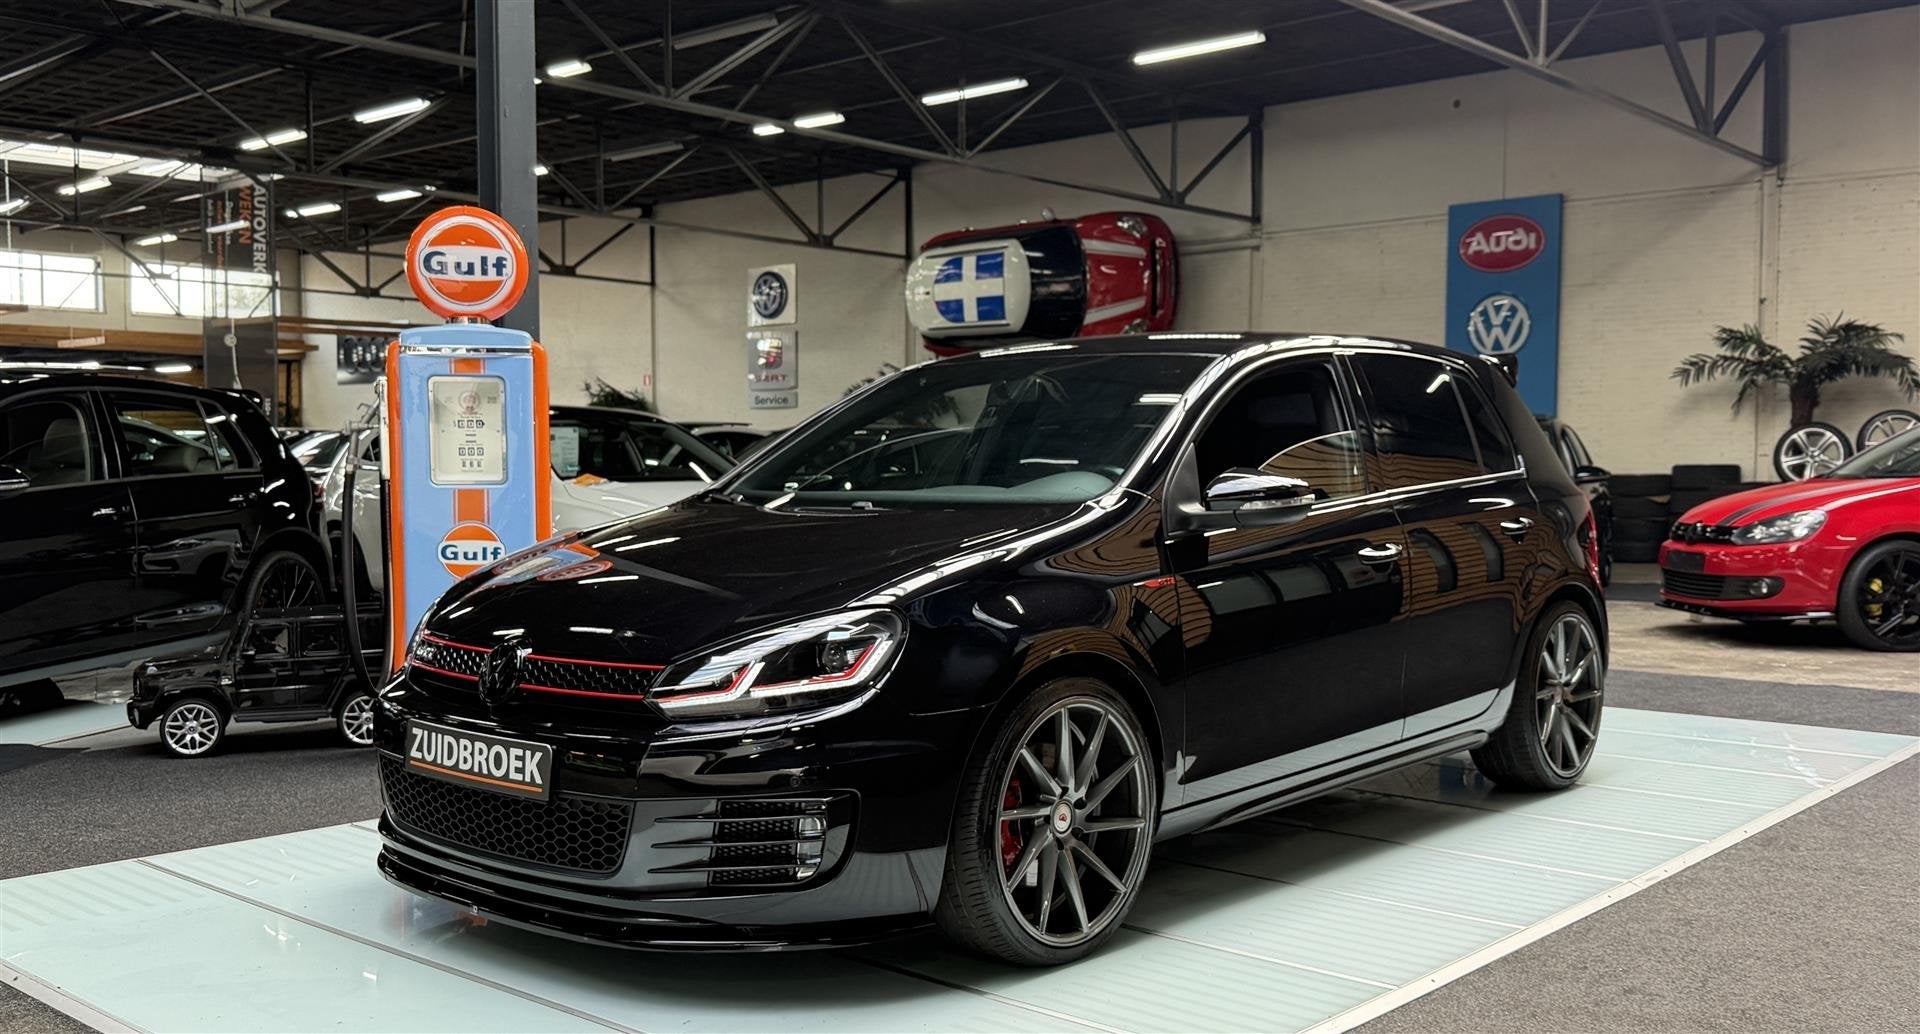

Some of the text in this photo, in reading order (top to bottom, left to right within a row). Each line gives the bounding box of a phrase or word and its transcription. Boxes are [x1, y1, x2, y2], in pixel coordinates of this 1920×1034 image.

[423, 251, 508, 277] Gulf
[754, 394, 790, 406] Service
[440, 544, 501, 561] Gulf
[410, 727, 544, 784] ZUIDBROEK
